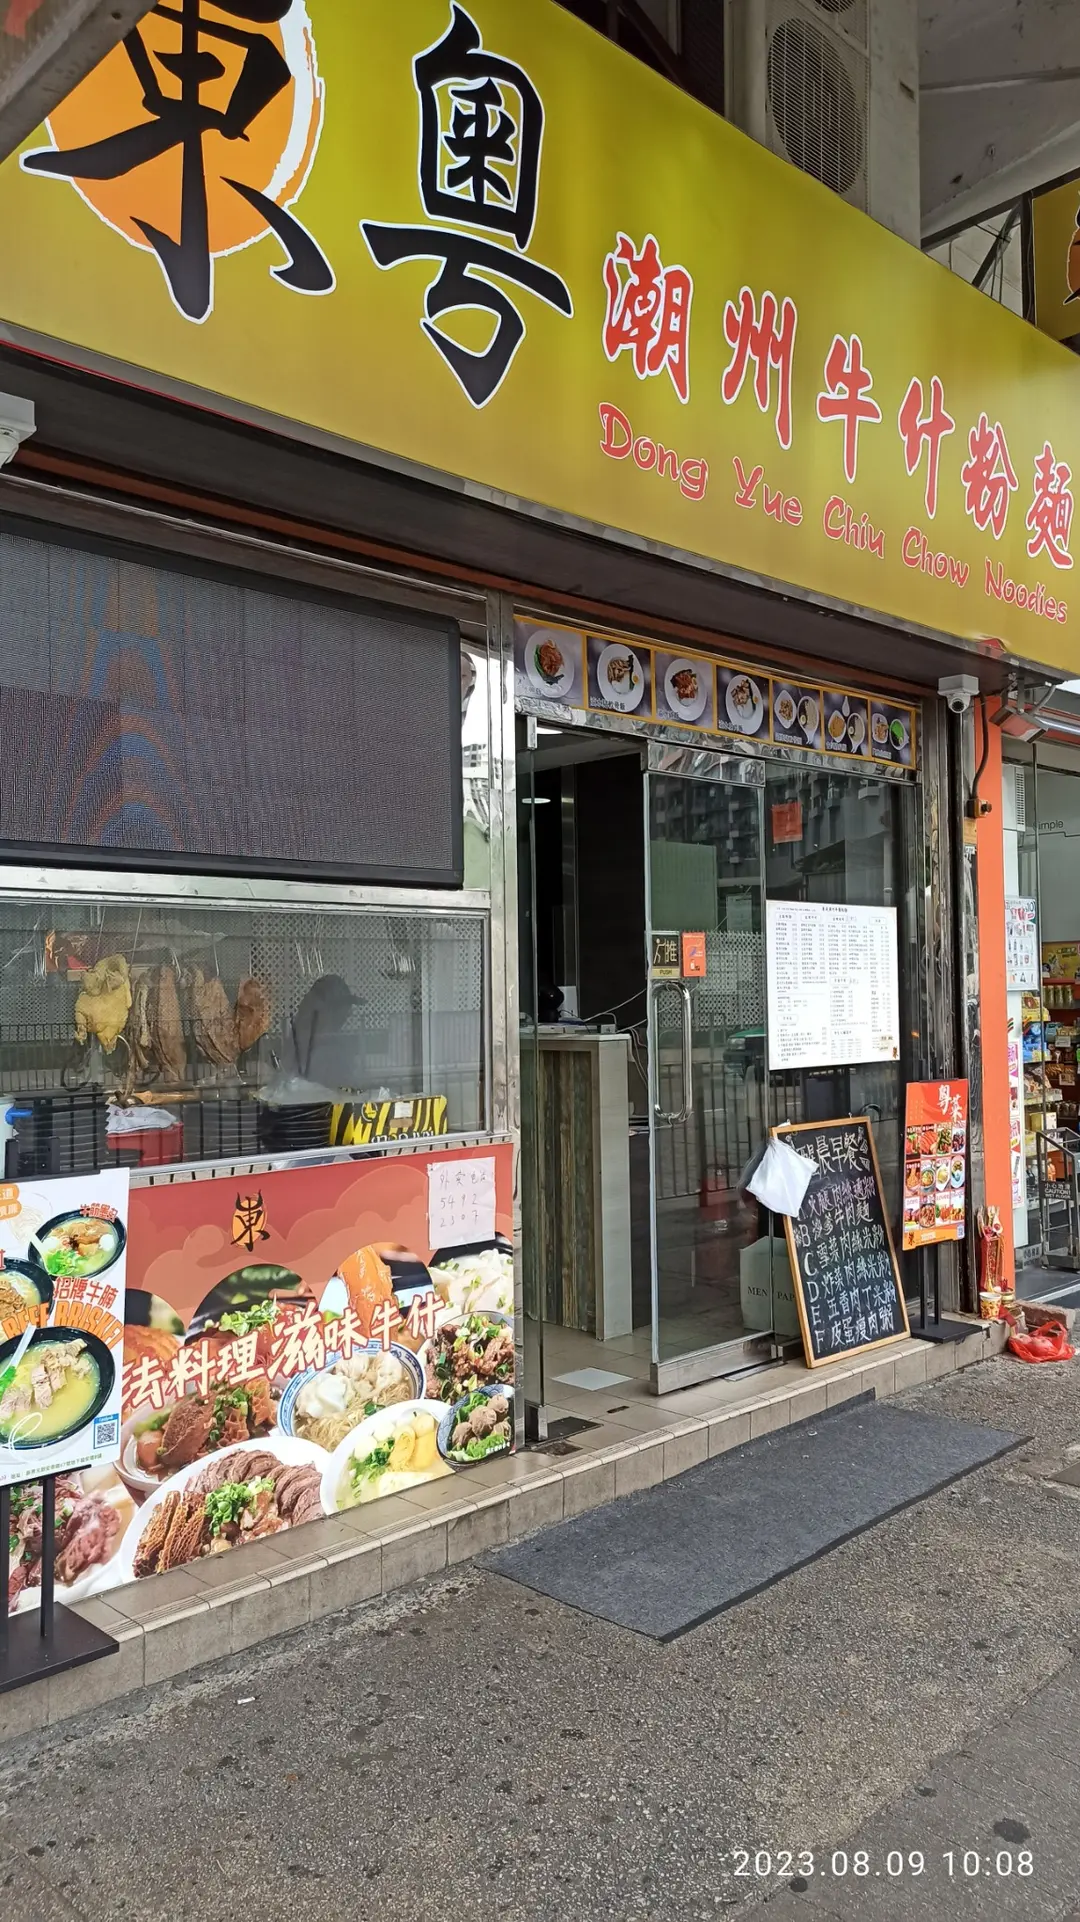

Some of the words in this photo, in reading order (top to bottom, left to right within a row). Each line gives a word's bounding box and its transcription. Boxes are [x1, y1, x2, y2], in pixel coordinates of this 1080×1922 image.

[602, 231, 1074, 569] 潮州牛什粉麵
[599, 402, 709, 501] Dong
[732, 456, 804, 526] Yue
[823, 495, 885, 559] Chiu
[902, 526, 970, 588] Chow
[54, 1277, 119, 1310] 招牌牛腩
[747, 1286, 768, 1296] MEN
